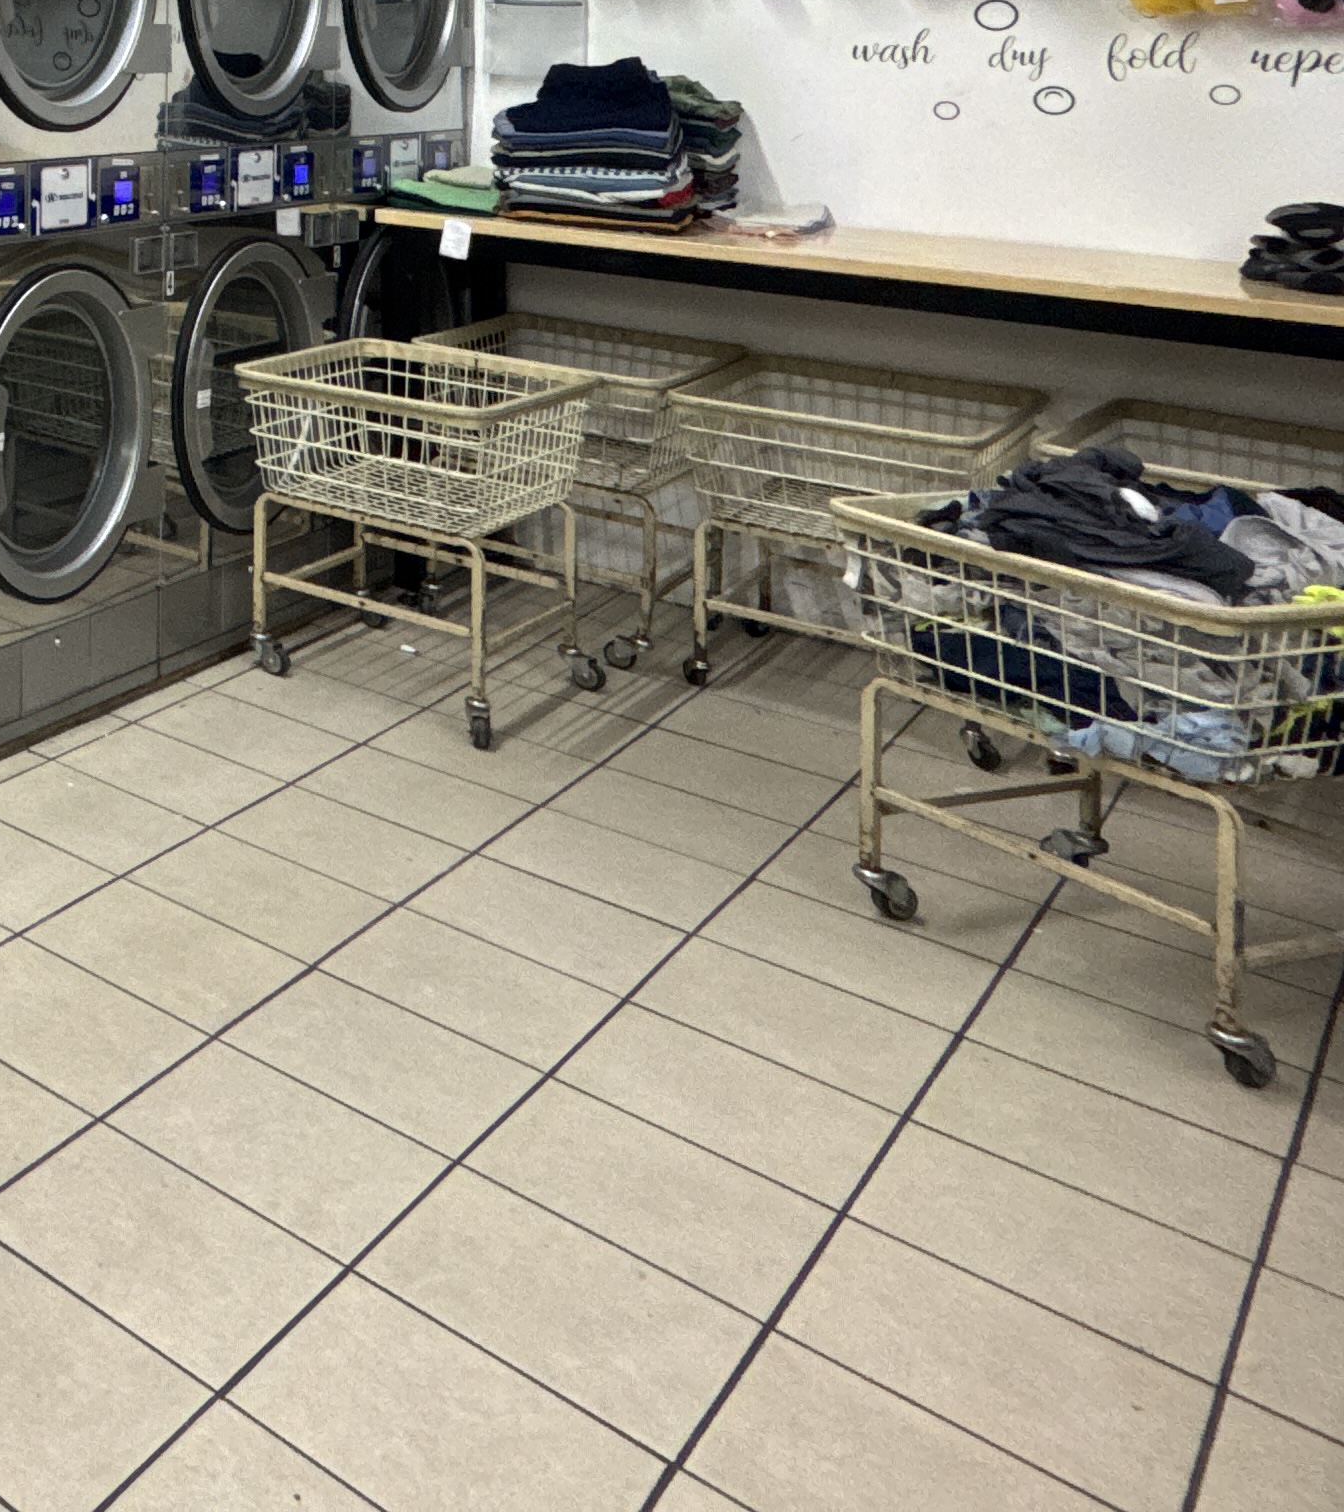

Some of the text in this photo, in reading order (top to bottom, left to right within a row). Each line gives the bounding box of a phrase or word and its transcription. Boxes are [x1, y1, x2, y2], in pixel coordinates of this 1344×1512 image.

[852, 28, 934, 69] wash
[988, 36, 1052, 81] dry
[1108, 32, 1200, 81] fold
